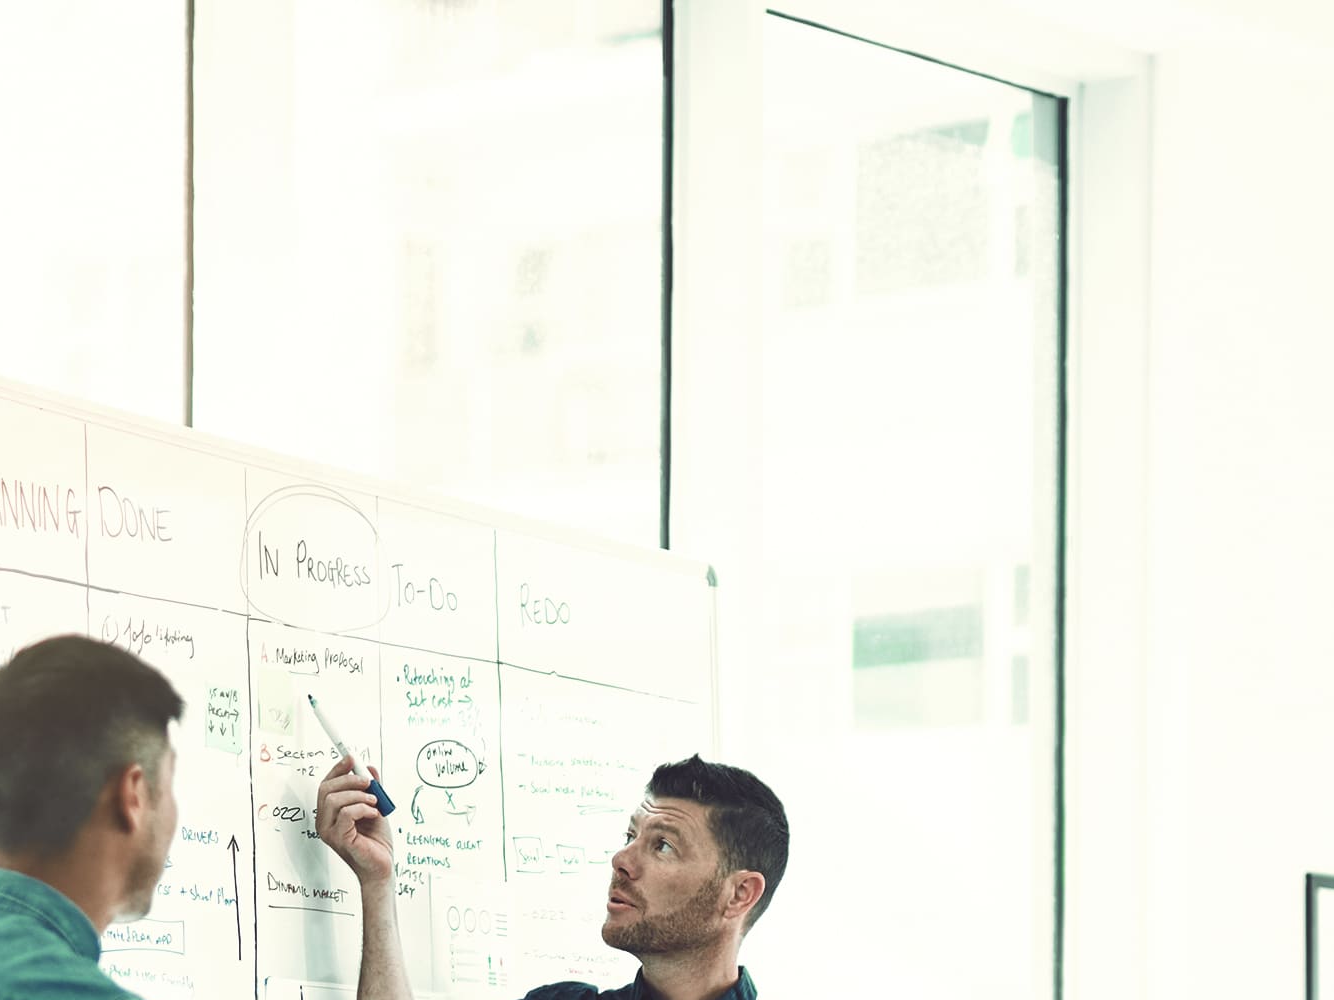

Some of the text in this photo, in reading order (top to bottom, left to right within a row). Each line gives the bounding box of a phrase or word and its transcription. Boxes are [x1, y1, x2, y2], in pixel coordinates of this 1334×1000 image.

[98, 485, 173, 542] DONE
[258, 530, 371, 588] IN PROGRESS
[276, 647, 320, 674] Marketing
[276, 745, 325, 760] Section
[406, 852, 451, 869] RELATIONS
